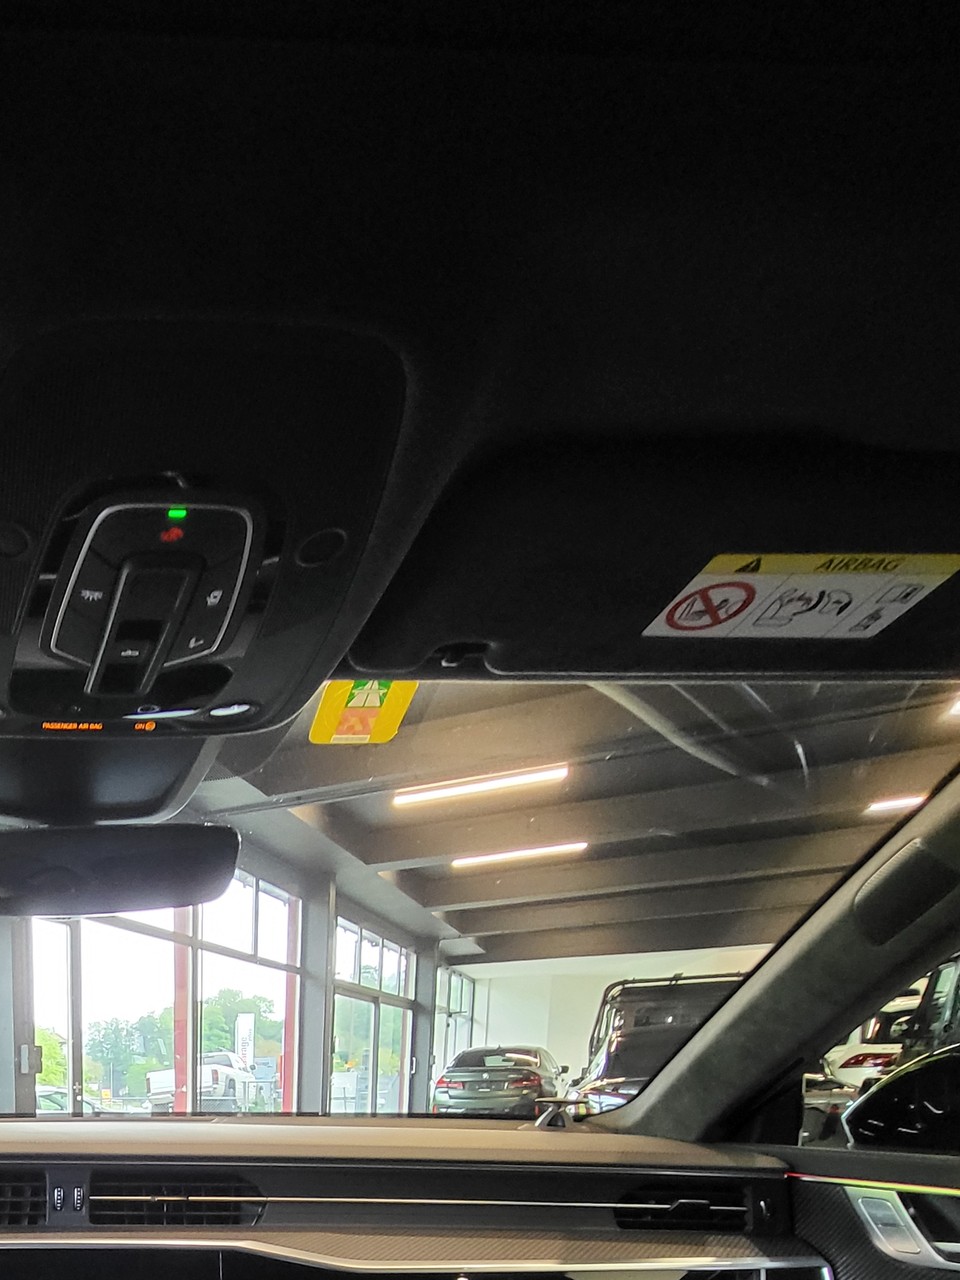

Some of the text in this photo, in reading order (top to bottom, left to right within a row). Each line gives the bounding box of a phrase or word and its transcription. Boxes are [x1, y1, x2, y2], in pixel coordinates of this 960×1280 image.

[815, 558, 903, 572] AIRBAG
[42, 722, 103, 730] PASSENGER AIR BAG
